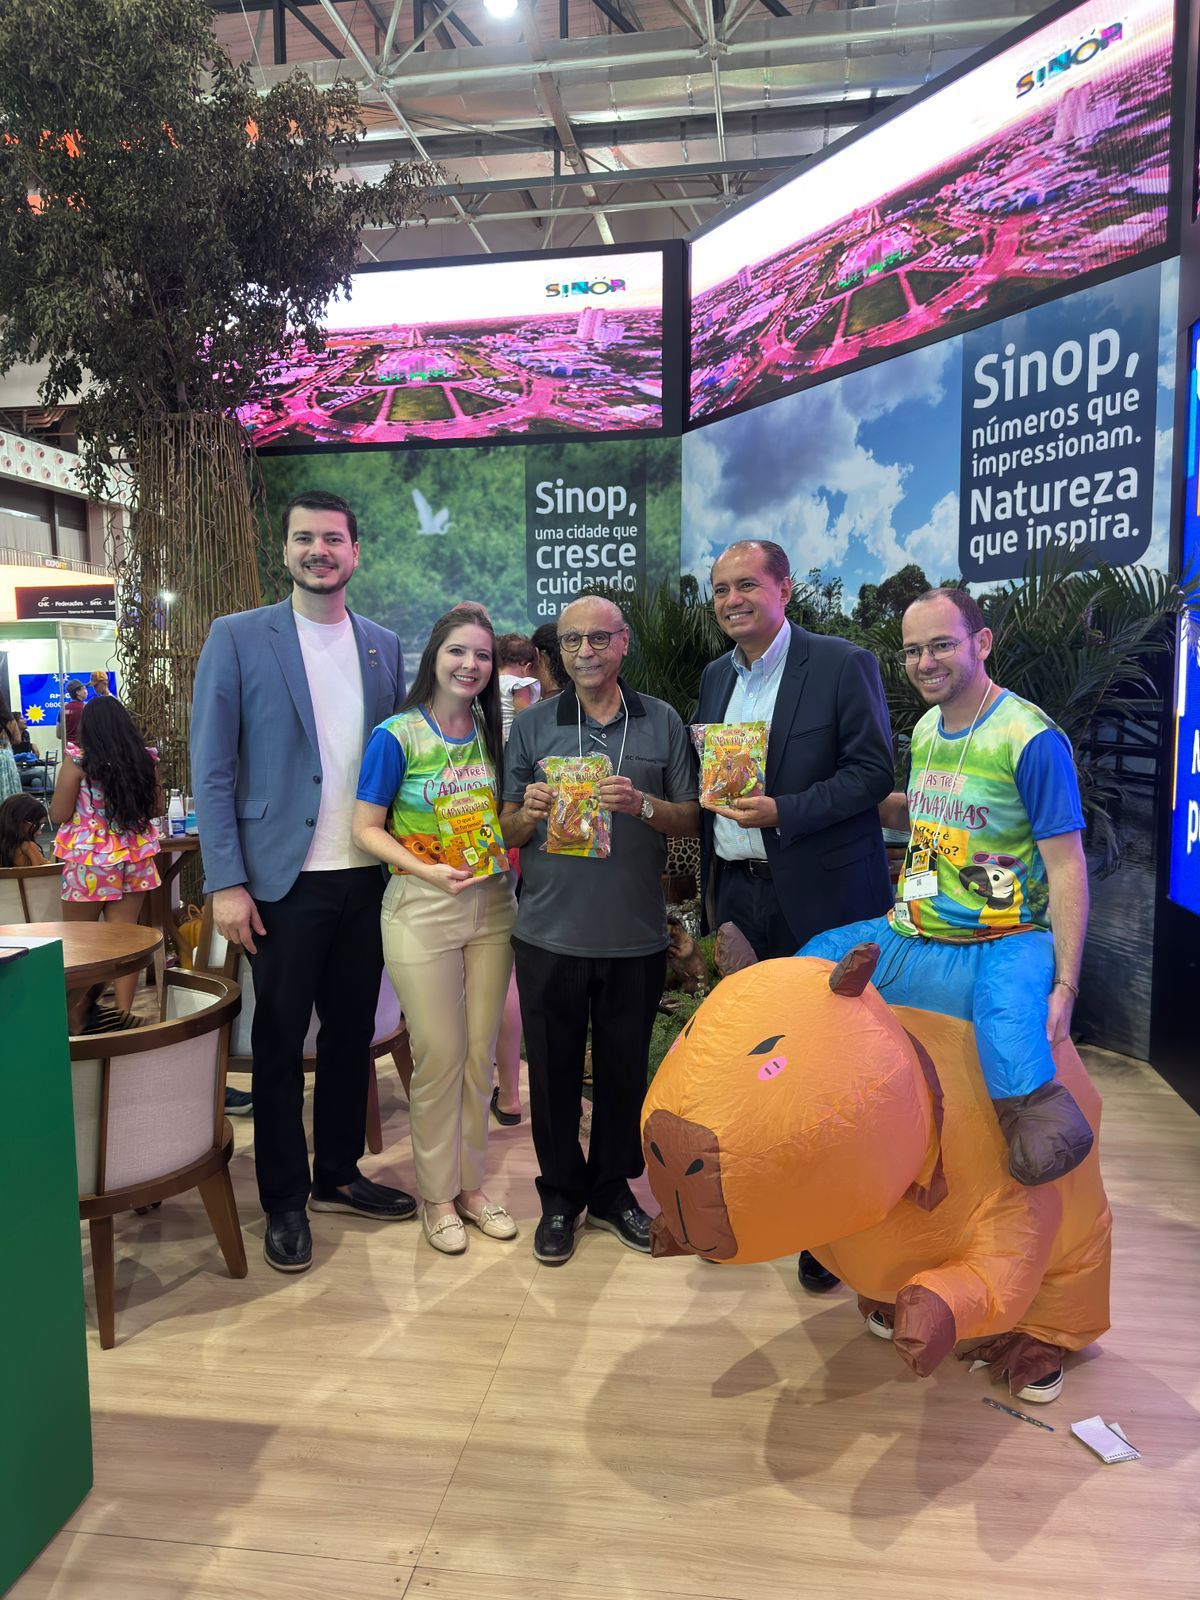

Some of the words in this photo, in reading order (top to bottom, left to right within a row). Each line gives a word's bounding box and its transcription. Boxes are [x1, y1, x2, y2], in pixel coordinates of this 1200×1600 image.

[1016, 22, 1123, 99] SINOP
[545, 277, 626, 298] SINOP
[973, 327, 1140, 409] Sinop,
[971, 403, 1080, 450] números
[1087, 387, 1140, 426] que
[971, 424, 1142, 478] impressionam.
[535, 478, 637, 520] Sinop,
[970, 466, 1139, 526] Natureza
[535, 528, 564, 540] uma
[566, 524, 610, 539] cidade
[613, 525, 638, 540] que
[969, 527, 1018, 565] que
[1026, 507, 1140, 553] inspira.
[536, 542, 637, 570] cresce
[537, 598, 557, 616] da
[926, 774, 937, 786] AS
[942, 831, 950, 841] é
